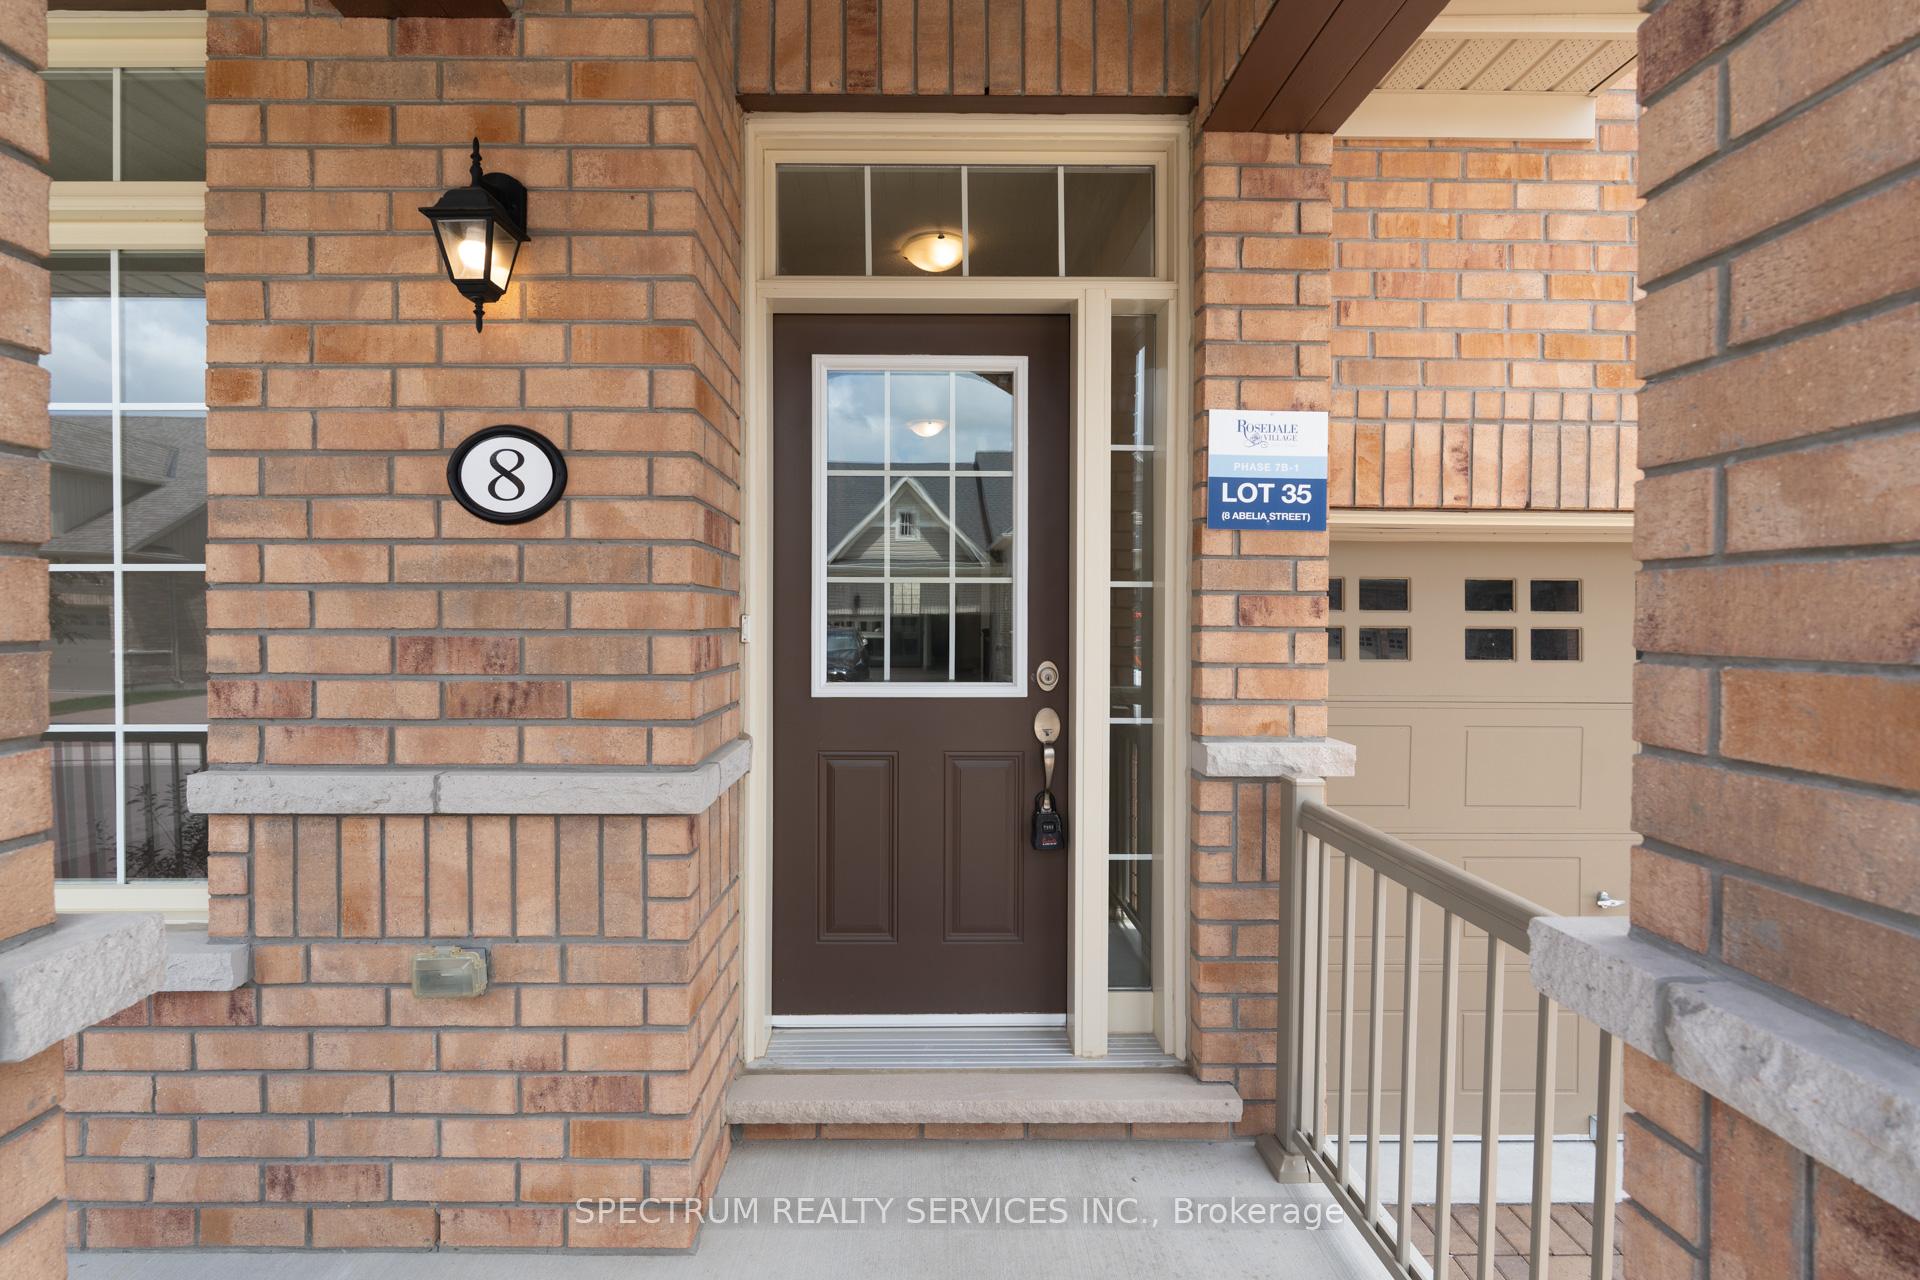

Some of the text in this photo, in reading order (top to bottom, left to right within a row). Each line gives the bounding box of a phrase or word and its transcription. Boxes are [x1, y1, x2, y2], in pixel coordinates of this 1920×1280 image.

[1236, 419, 1299, 434] ROSEDALE
[487, 448, 526, 502] 8
[1233, 462, 1300, 473] PHASE 7B-1
[1221, 482, 1313, 505] LOT 35
[1221, 511, 1311, 523] (8 ABELIA STREET)
